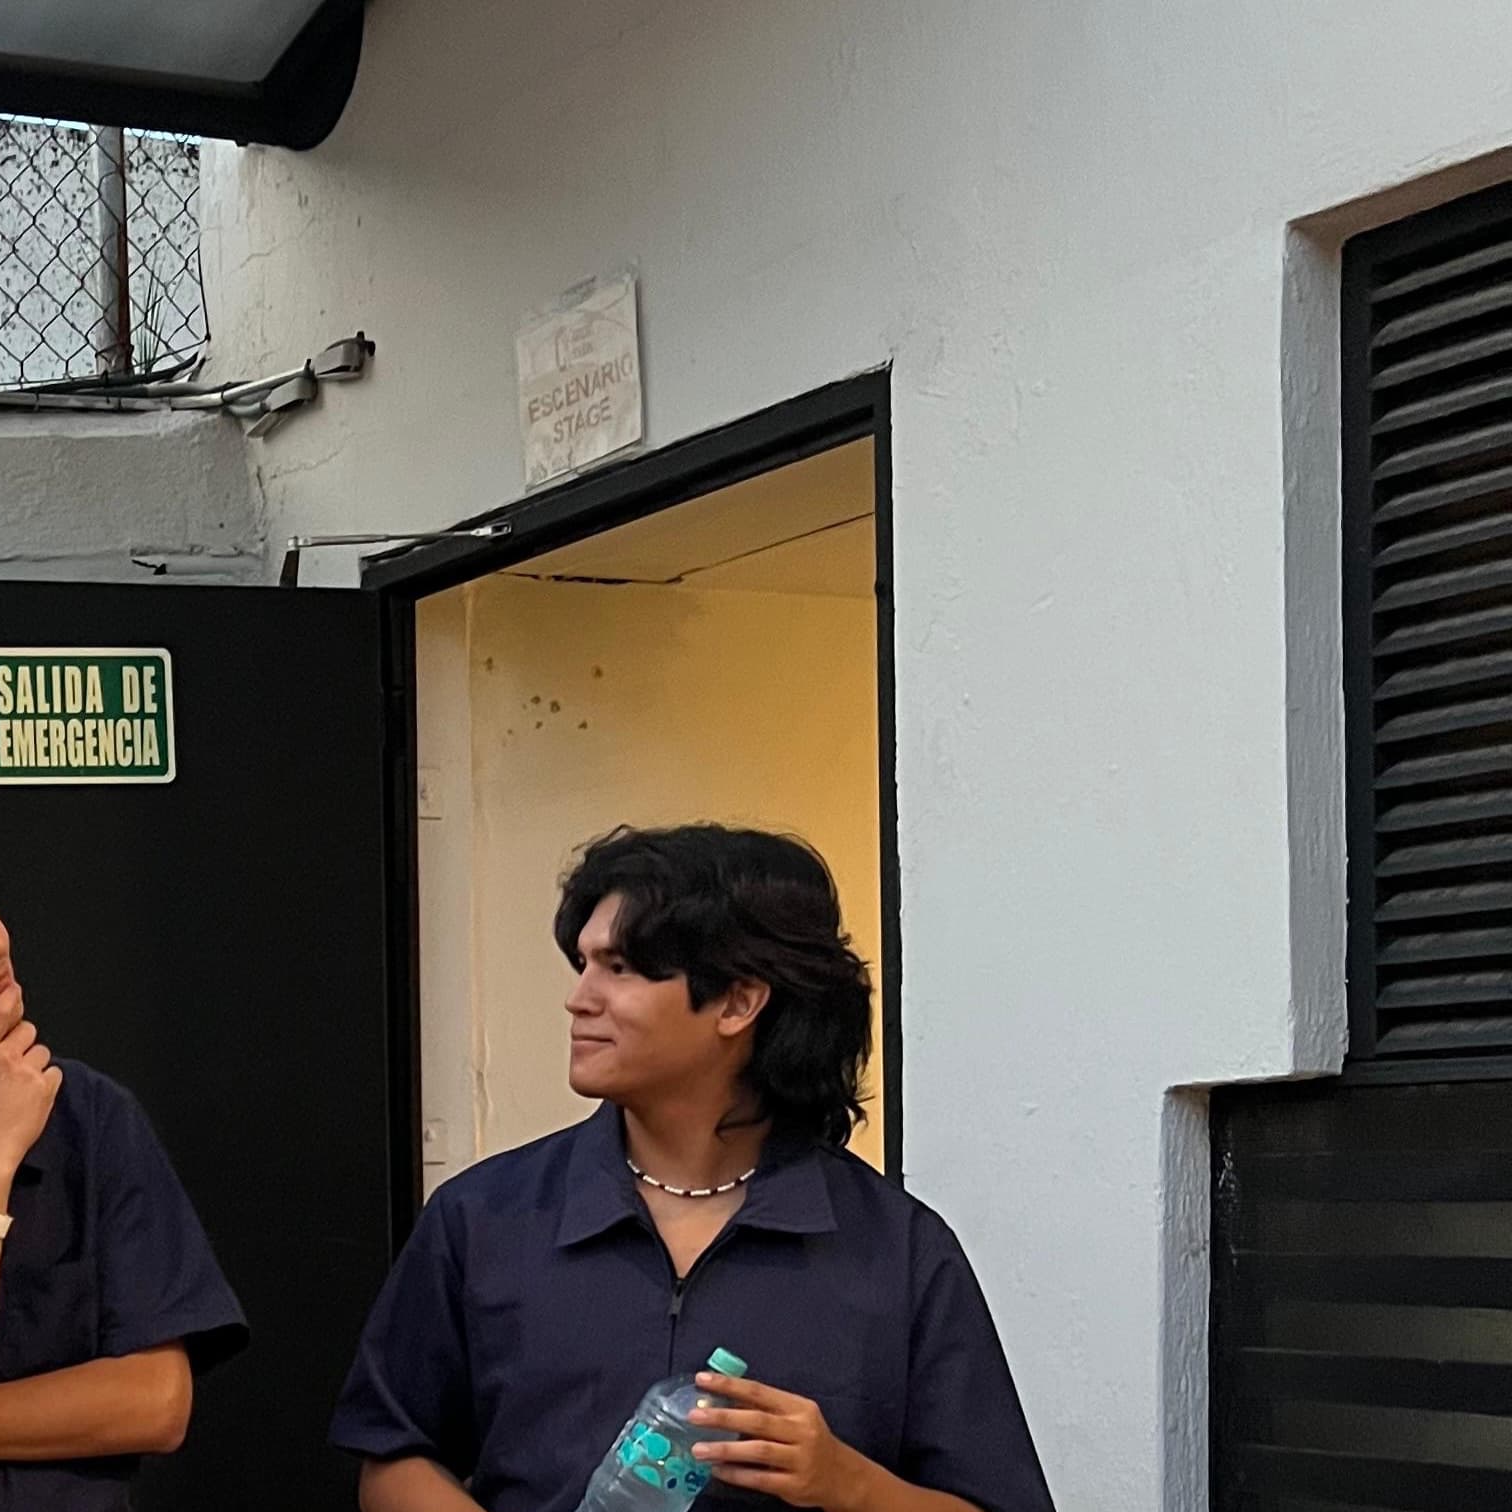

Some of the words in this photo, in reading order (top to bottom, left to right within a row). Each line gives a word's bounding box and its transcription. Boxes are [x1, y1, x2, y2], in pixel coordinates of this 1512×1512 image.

[528, 352, 634, 424] ESCENARIO
[553, 397, 612, 443] STAGE
[122, 666, 157, 713] DE
